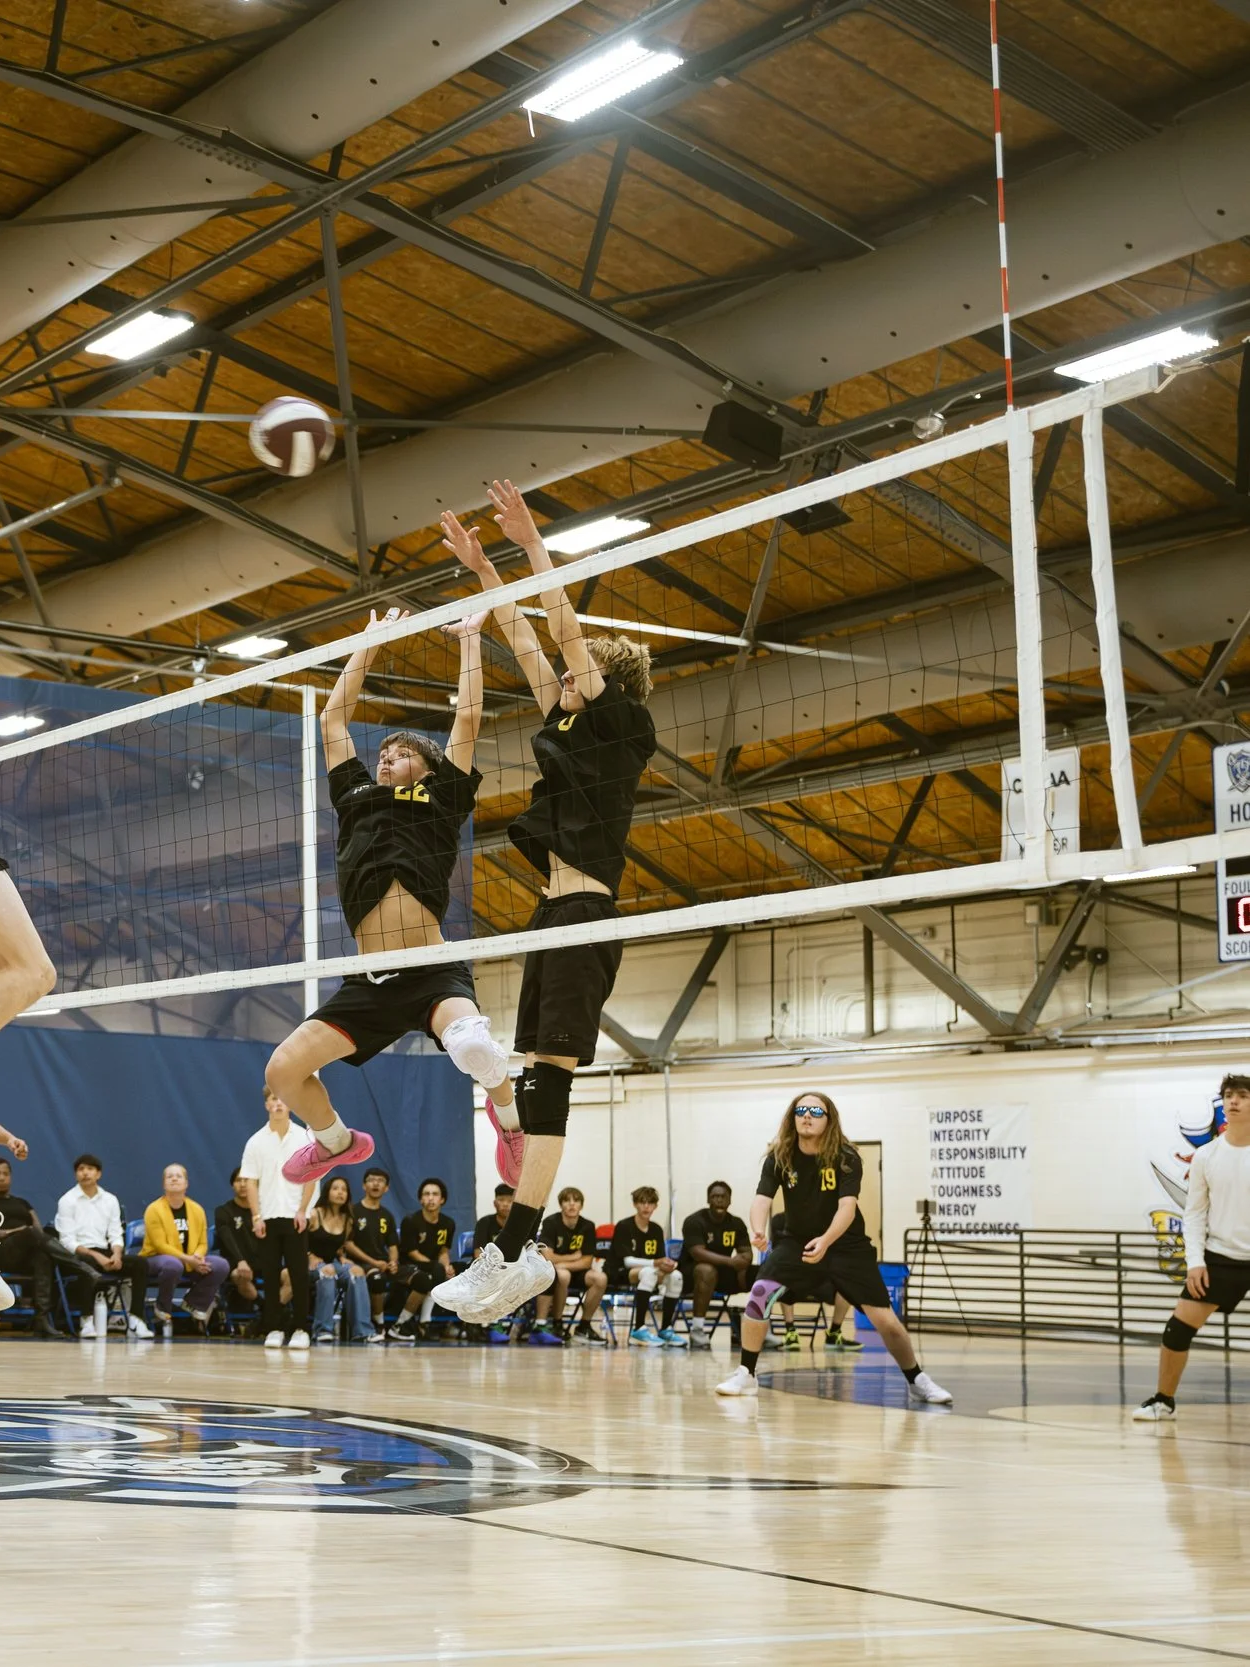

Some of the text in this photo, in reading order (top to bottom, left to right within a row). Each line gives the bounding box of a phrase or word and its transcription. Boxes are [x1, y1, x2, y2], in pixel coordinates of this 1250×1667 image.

[929, 1109, 984, 1124] PURPOSE
[930, 1128, 991, 1142] INTEGRITY
[930, 1147, 1027, 1160] RESPONSIBILITY
[820, 1167, 836, 1191] 19
[931, 1166, 986, 1179] ATTITUDE
[931, 1184, 1002, 1198] TOUGHNESS
[937, 1203, 977, 1217] NERGY
[379, 1217, 388, 1234] 5
[722, 1230, 736, 1247] 67
